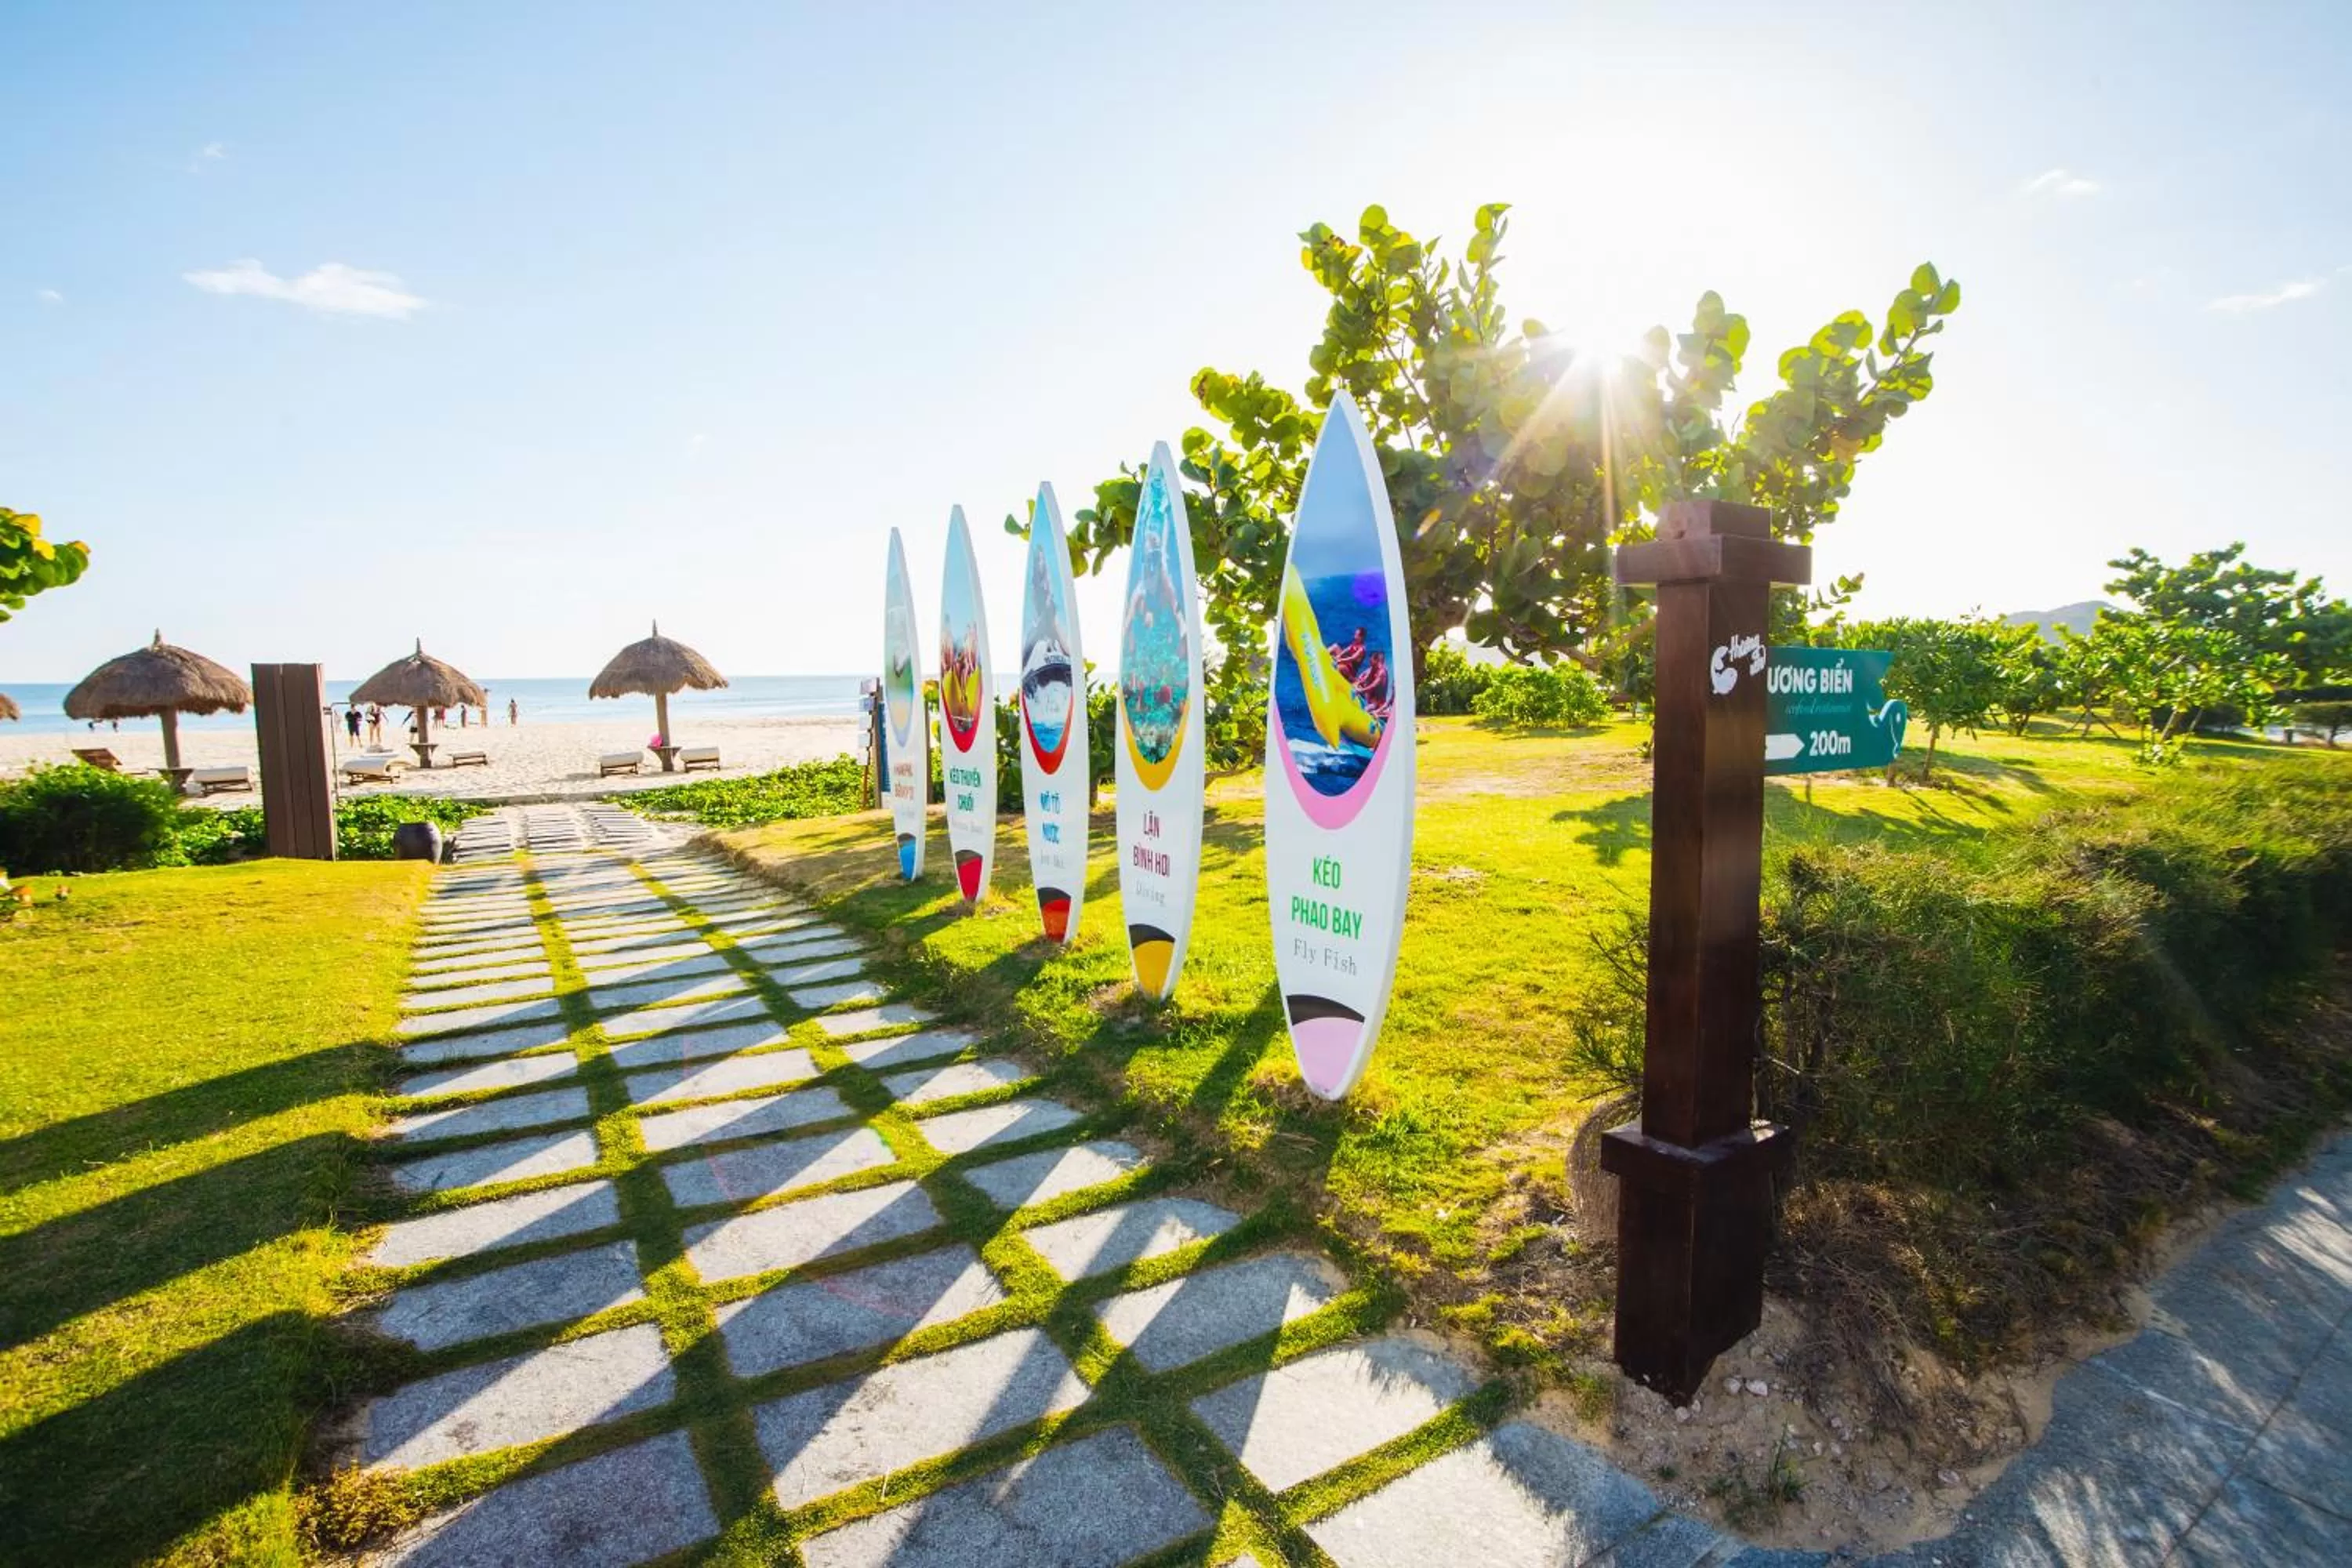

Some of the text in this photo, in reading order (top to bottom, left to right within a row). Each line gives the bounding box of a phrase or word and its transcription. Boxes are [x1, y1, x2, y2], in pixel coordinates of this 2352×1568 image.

[1766, 657, 1853, 694] ƯƠNG BIỂN
[1809, 730, 1851, 757] 200m
[1133, 842, 1153, 872] BÌNH
[1312, 855, 1341, 889] KÉO
[1291, 895, 1363, 940] PHAO BAY
[1294, 938, 1358, 976] Fly Fish
